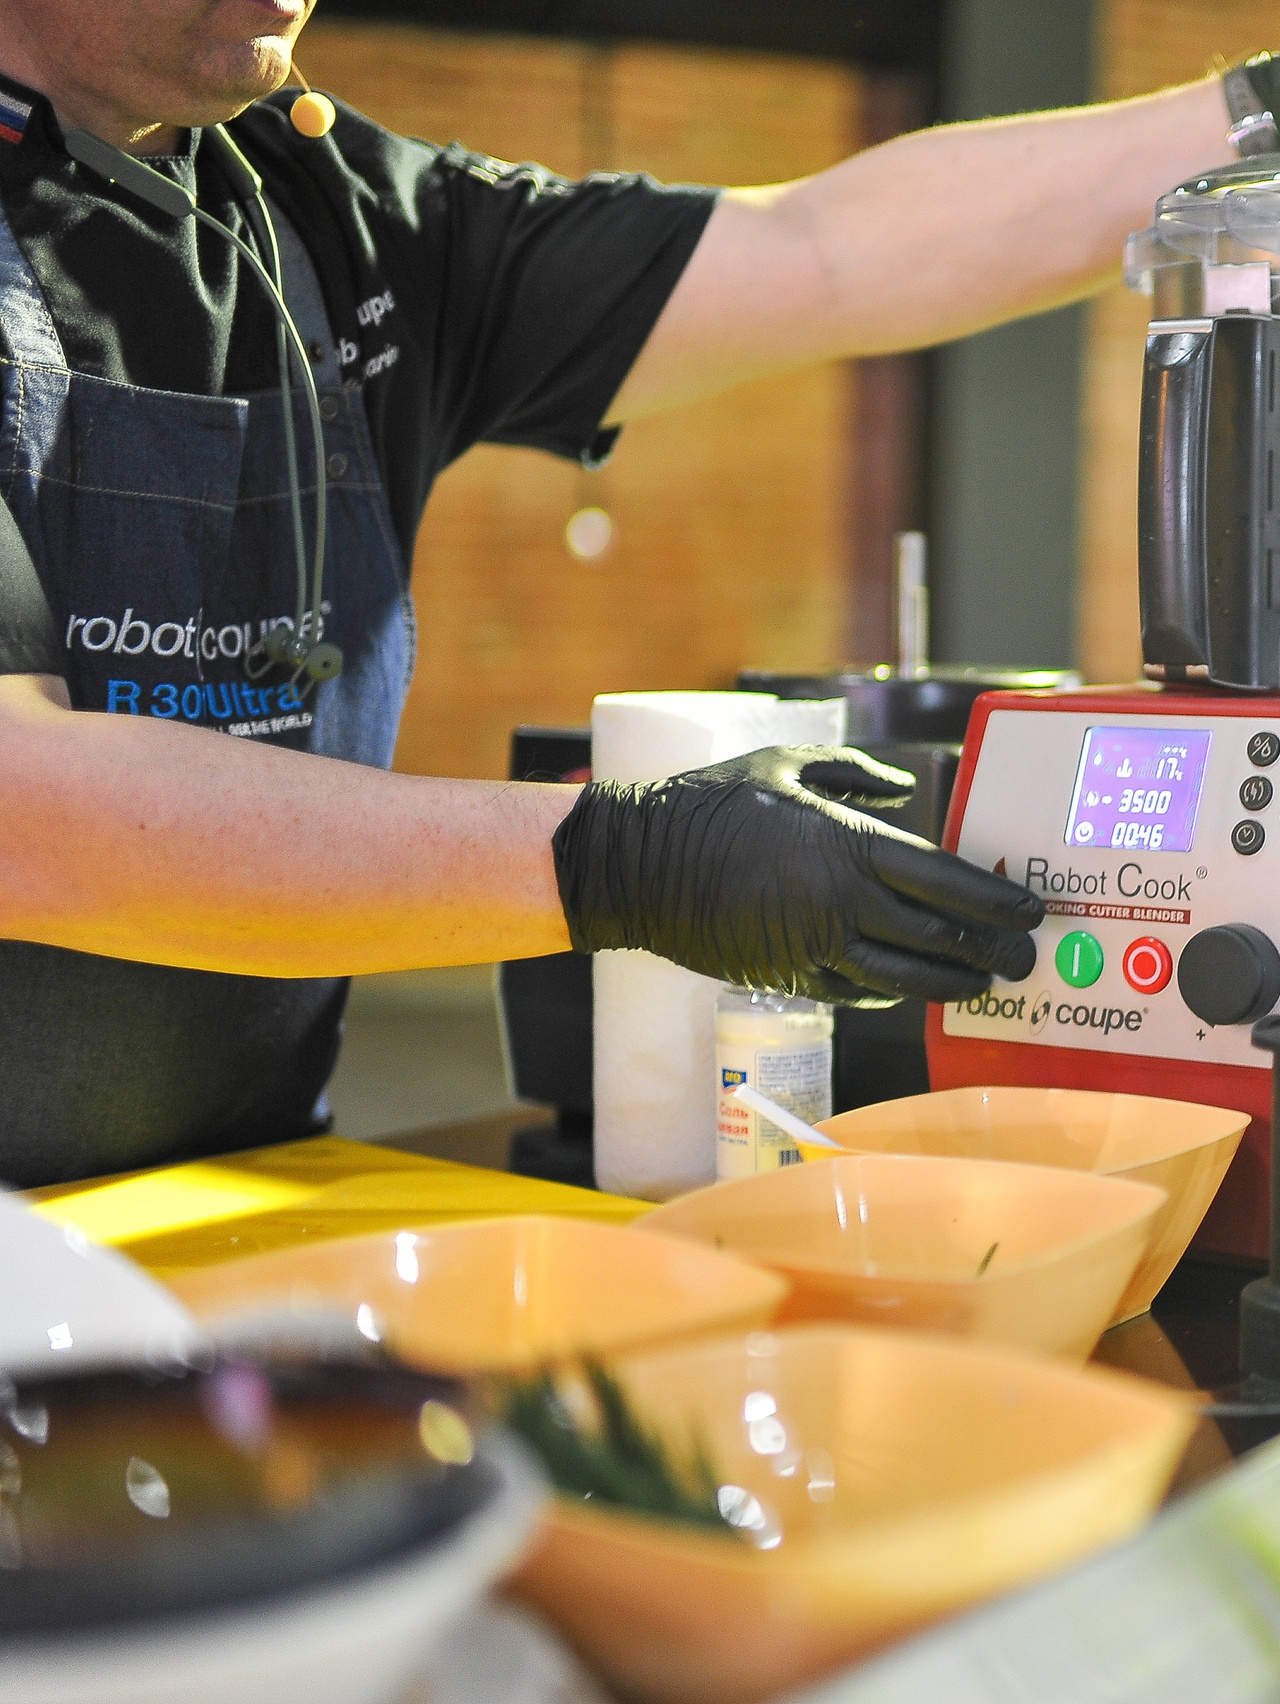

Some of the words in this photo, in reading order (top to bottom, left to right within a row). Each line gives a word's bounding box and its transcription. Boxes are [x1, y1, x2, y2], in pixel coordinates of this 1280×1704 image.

[65, 607, 195, 658] robot
[1117, 787, 1172, 815] 3500
[1024, 857, 1108, 895] Robot
[1117, 862, 1192, 902] Cook
[1046, 902, 1087, 916] OKING
[1088, 904, 1131, 919] CUTTER
[1132, 907, 1186, 923] BLENDER
[1055, 1003, 1142, 1036] coupe
